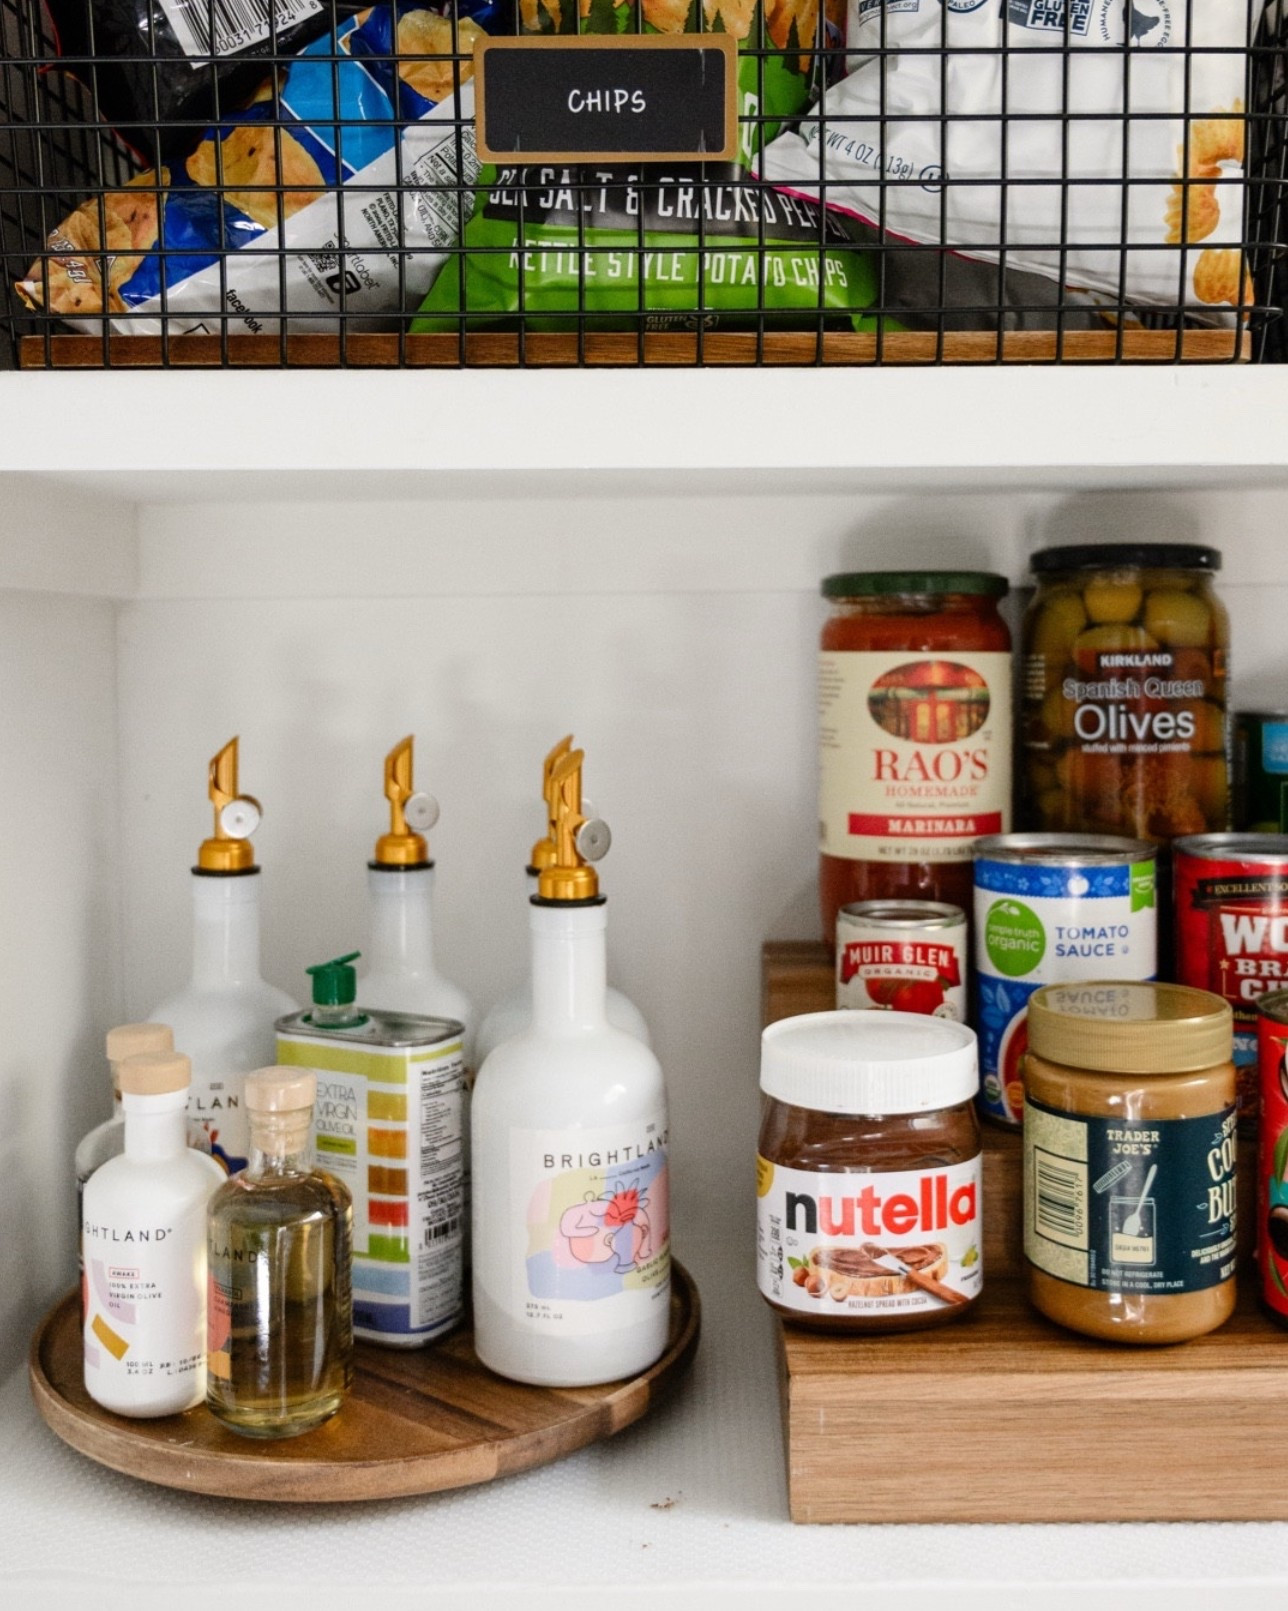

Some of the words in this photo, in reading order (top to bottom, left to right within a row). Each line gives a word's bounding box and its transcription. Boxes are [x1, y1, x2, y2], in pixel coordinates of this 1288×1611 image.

[1033, 0, 1090, 14] GLUEN
[567, 89, 647, 113] CHIPS
[845, 139, 856, 155] 4
[855, 143, 874, 164] OZ
[873, 155, 914, 180] (13g)
[657, 176, 778, 224] CRACKED
[509, 238, 597, 276] KETTLE
[607, 247, 686, 281] STYLE
[697, 250, 786, 287] POTATO
[791, 257, 848, 288] CHPS
[1100, 654, 1172, 667] KIRKLAND
[1063, 677, 1141, 702] Spanish
[1143, 676, 1204, 699] Queen
[1074, 703, 1196, 740] Olives
[872, 749, 988, 782] RAO'S
[885, 784, 977, 797] HOMEMADE
[887, 819, 977, 833] MARINARA
[1055, 925, 1129, 940] TOMATO
[1219, 913, 1288, 956] WO
[988, 934, 1041, 952] organic
[1055, 944, 1116, 957] SAUCE
[849, 945, 894, 965] MUIR
[902, 945, 950, 967] GLEN
[863, 967, 932, 978] ORGANIC
[317, 1082, 357, 1102] EXTRA
[317, 1102, 358, 1121] VIRGIN
[1106, 1130, 1160, 1143] TRADER
[1113, 1143, 1152, 1155] JOE'S
[785, 1174, 977, 1237] nutella
